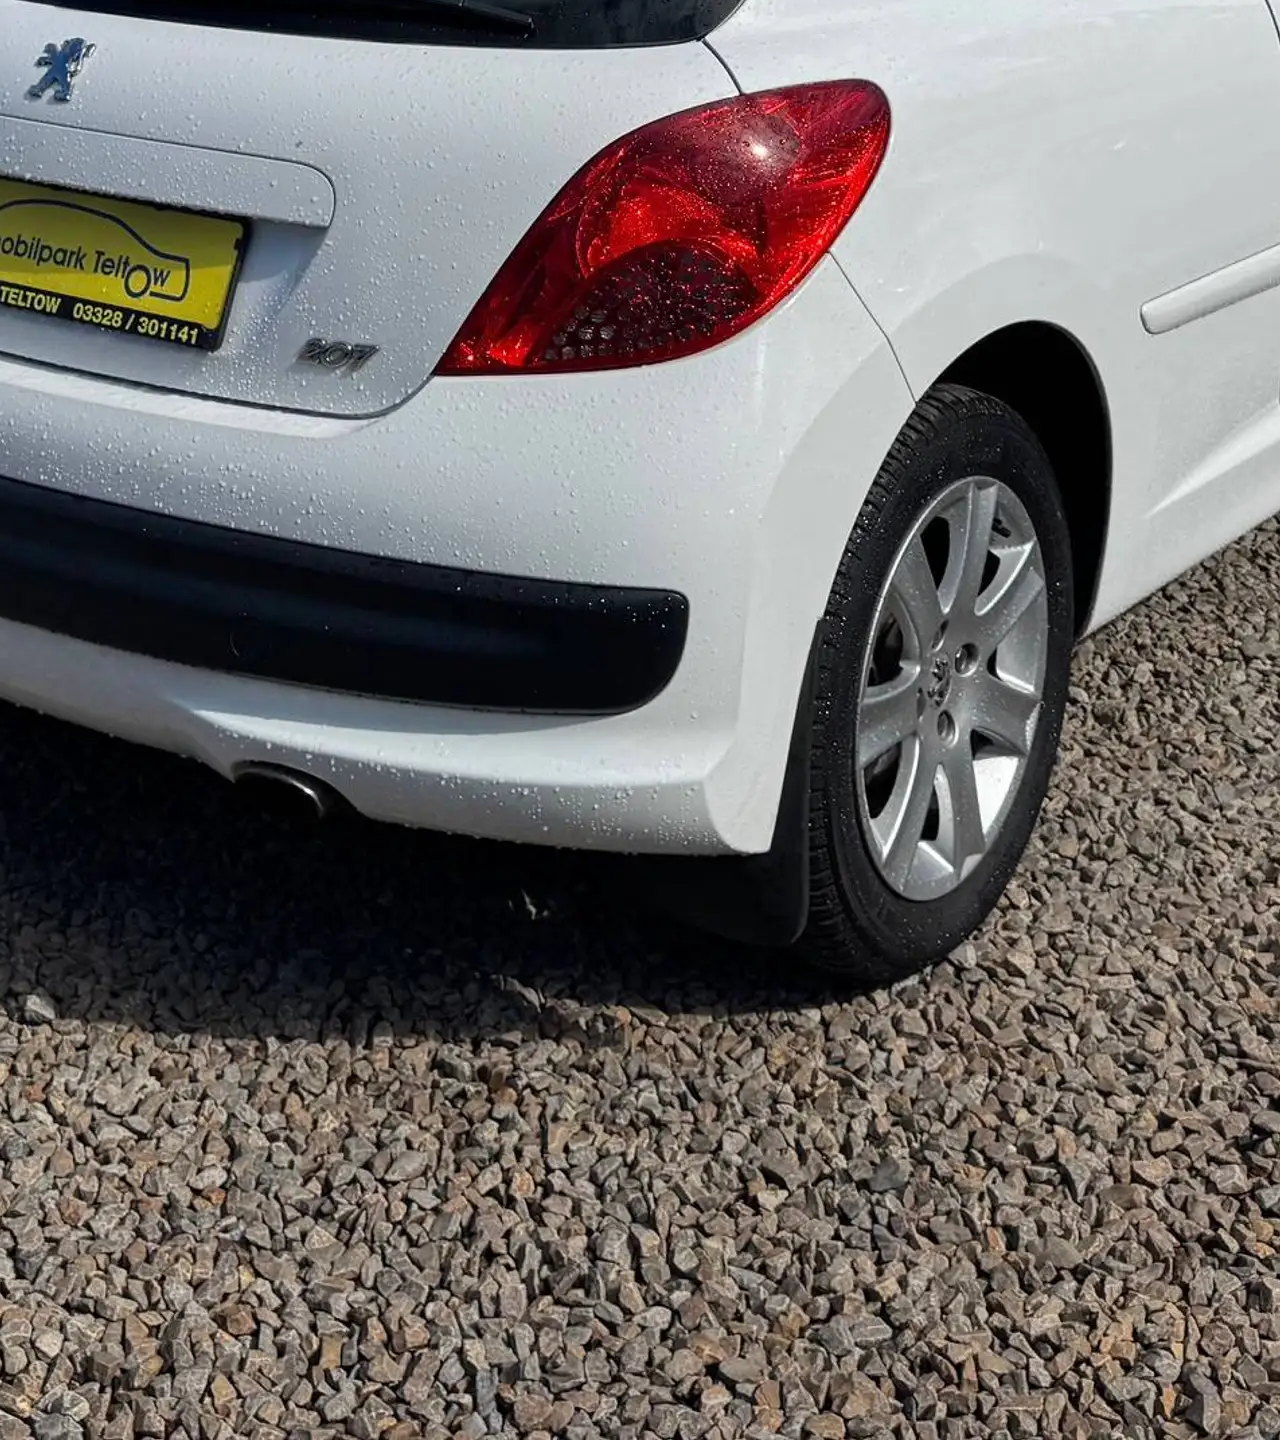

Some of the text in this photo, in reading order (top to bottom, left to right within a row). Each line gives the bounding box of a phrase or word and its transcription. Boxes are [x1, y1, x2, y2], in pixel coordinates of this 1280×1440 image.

[94, 250, 171, 299] Teltow
[0, 286, 61, 314] TELTOW
[73, 302, 123, 328] 03328
[125, 314, 133, 331] /
[137, 317, 200, 345] 301141
